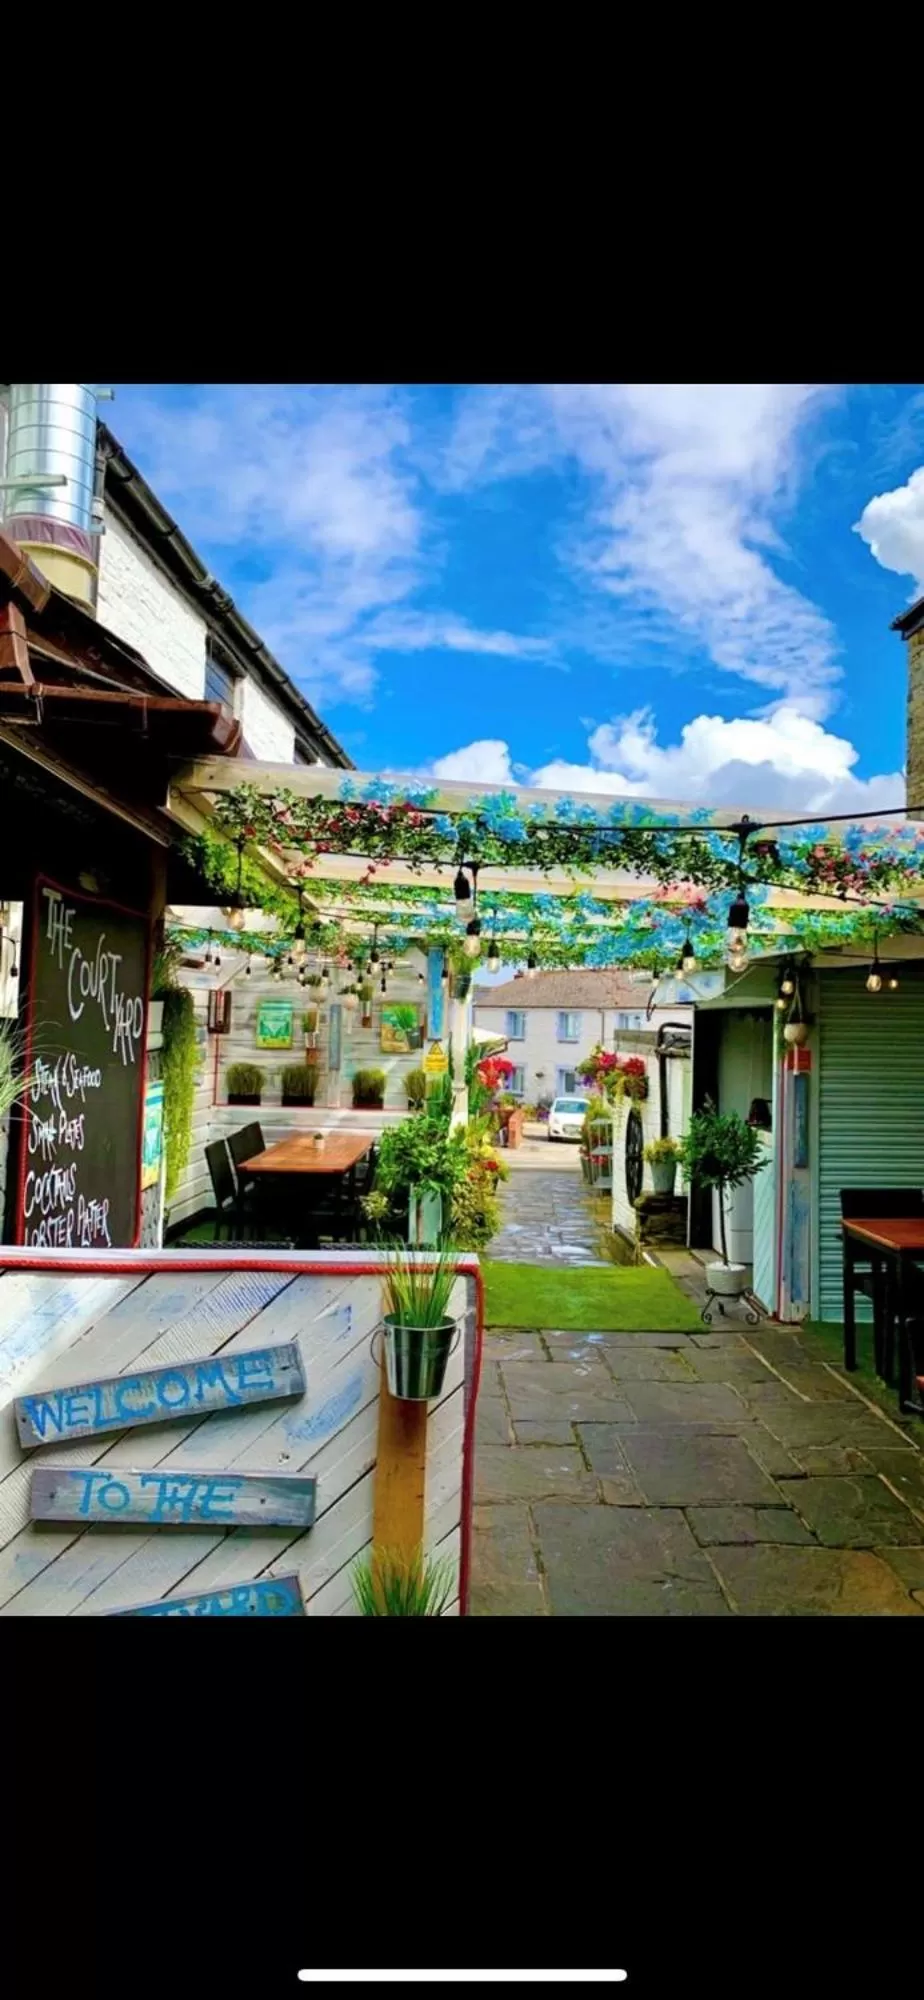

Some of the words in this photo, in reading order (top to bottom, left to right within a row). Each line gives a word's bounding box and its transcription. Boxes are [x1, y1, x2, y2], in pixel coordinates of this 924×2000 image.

[42, 887, 76, 969] THE
[24, 1162, 77, 1217] COCKTAILS
[25, 1353, 275, 1437] WELCOME
[68, 1471, 131, 1514] TO
[140, 1472, 244, 1522] THE
